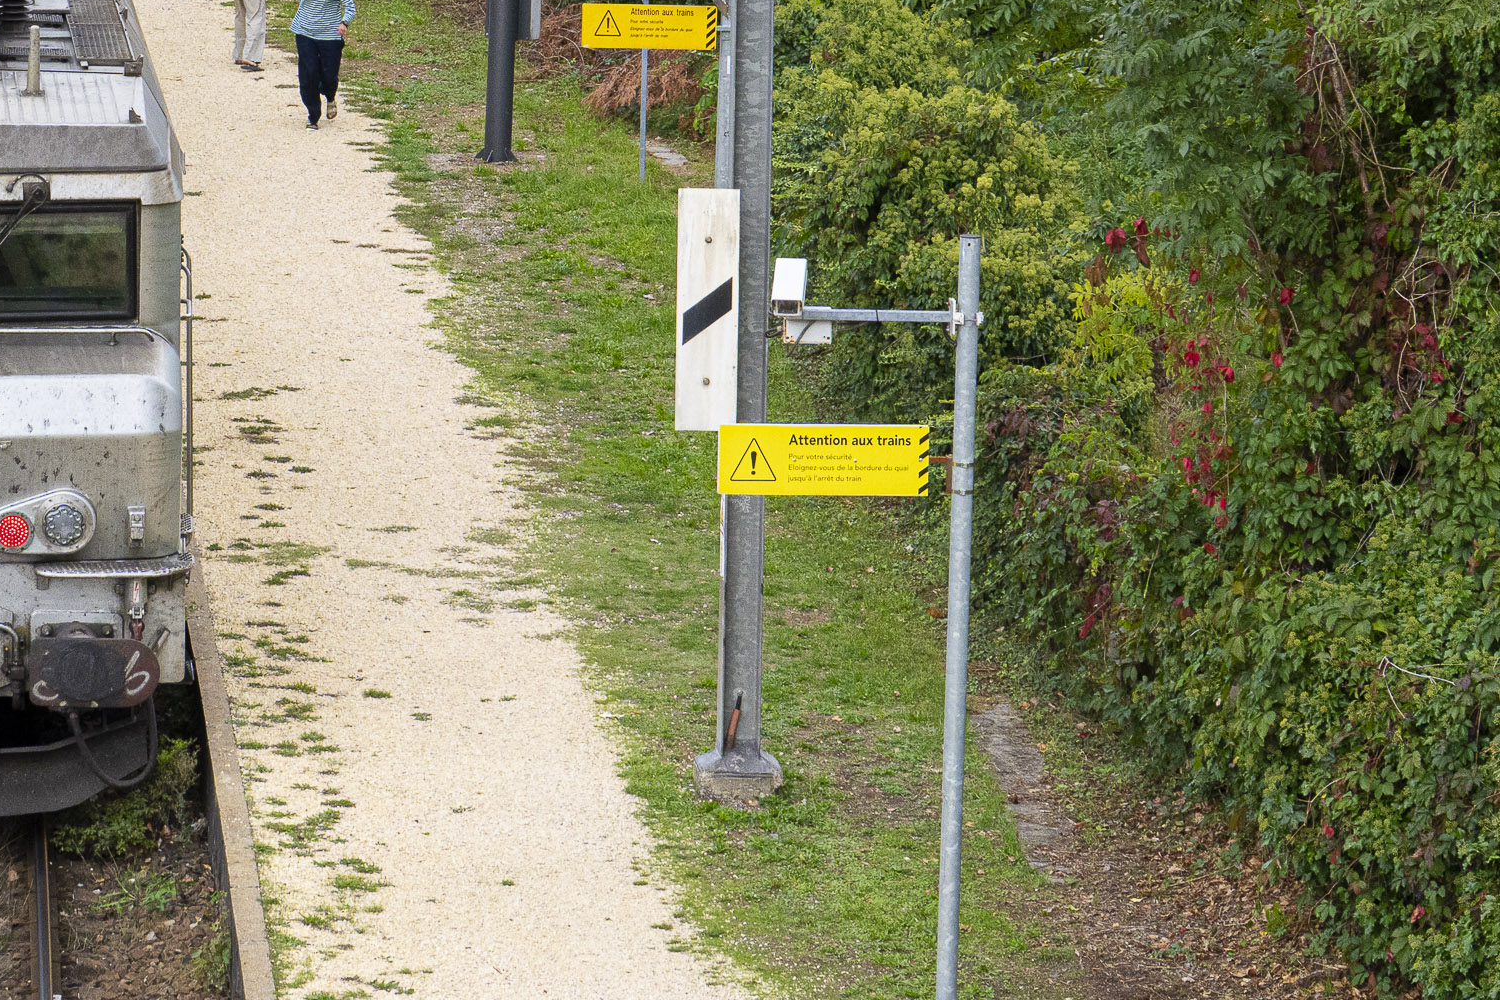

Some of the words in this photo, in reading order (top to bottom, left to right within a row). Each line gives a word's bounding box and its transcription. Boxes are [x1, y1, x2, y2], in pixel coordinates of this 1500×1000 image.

[630, 8, 659, 16] Attention
[788, 434, 847, 446] Attention
[851, 436, 872, 446] aux
[877, 435, 912, 446] trains
[788, 453, 804, 461] Pour
[826, 453, 852, 461] sécurité
[788, 464, 834, 473] Eloignez-vous
[854, 464, 881, 472] bordure
[883, 464, 893, 472] du
[894, 465, 909, 474] quai
[788, 475, 812, 484] jusqu'à
